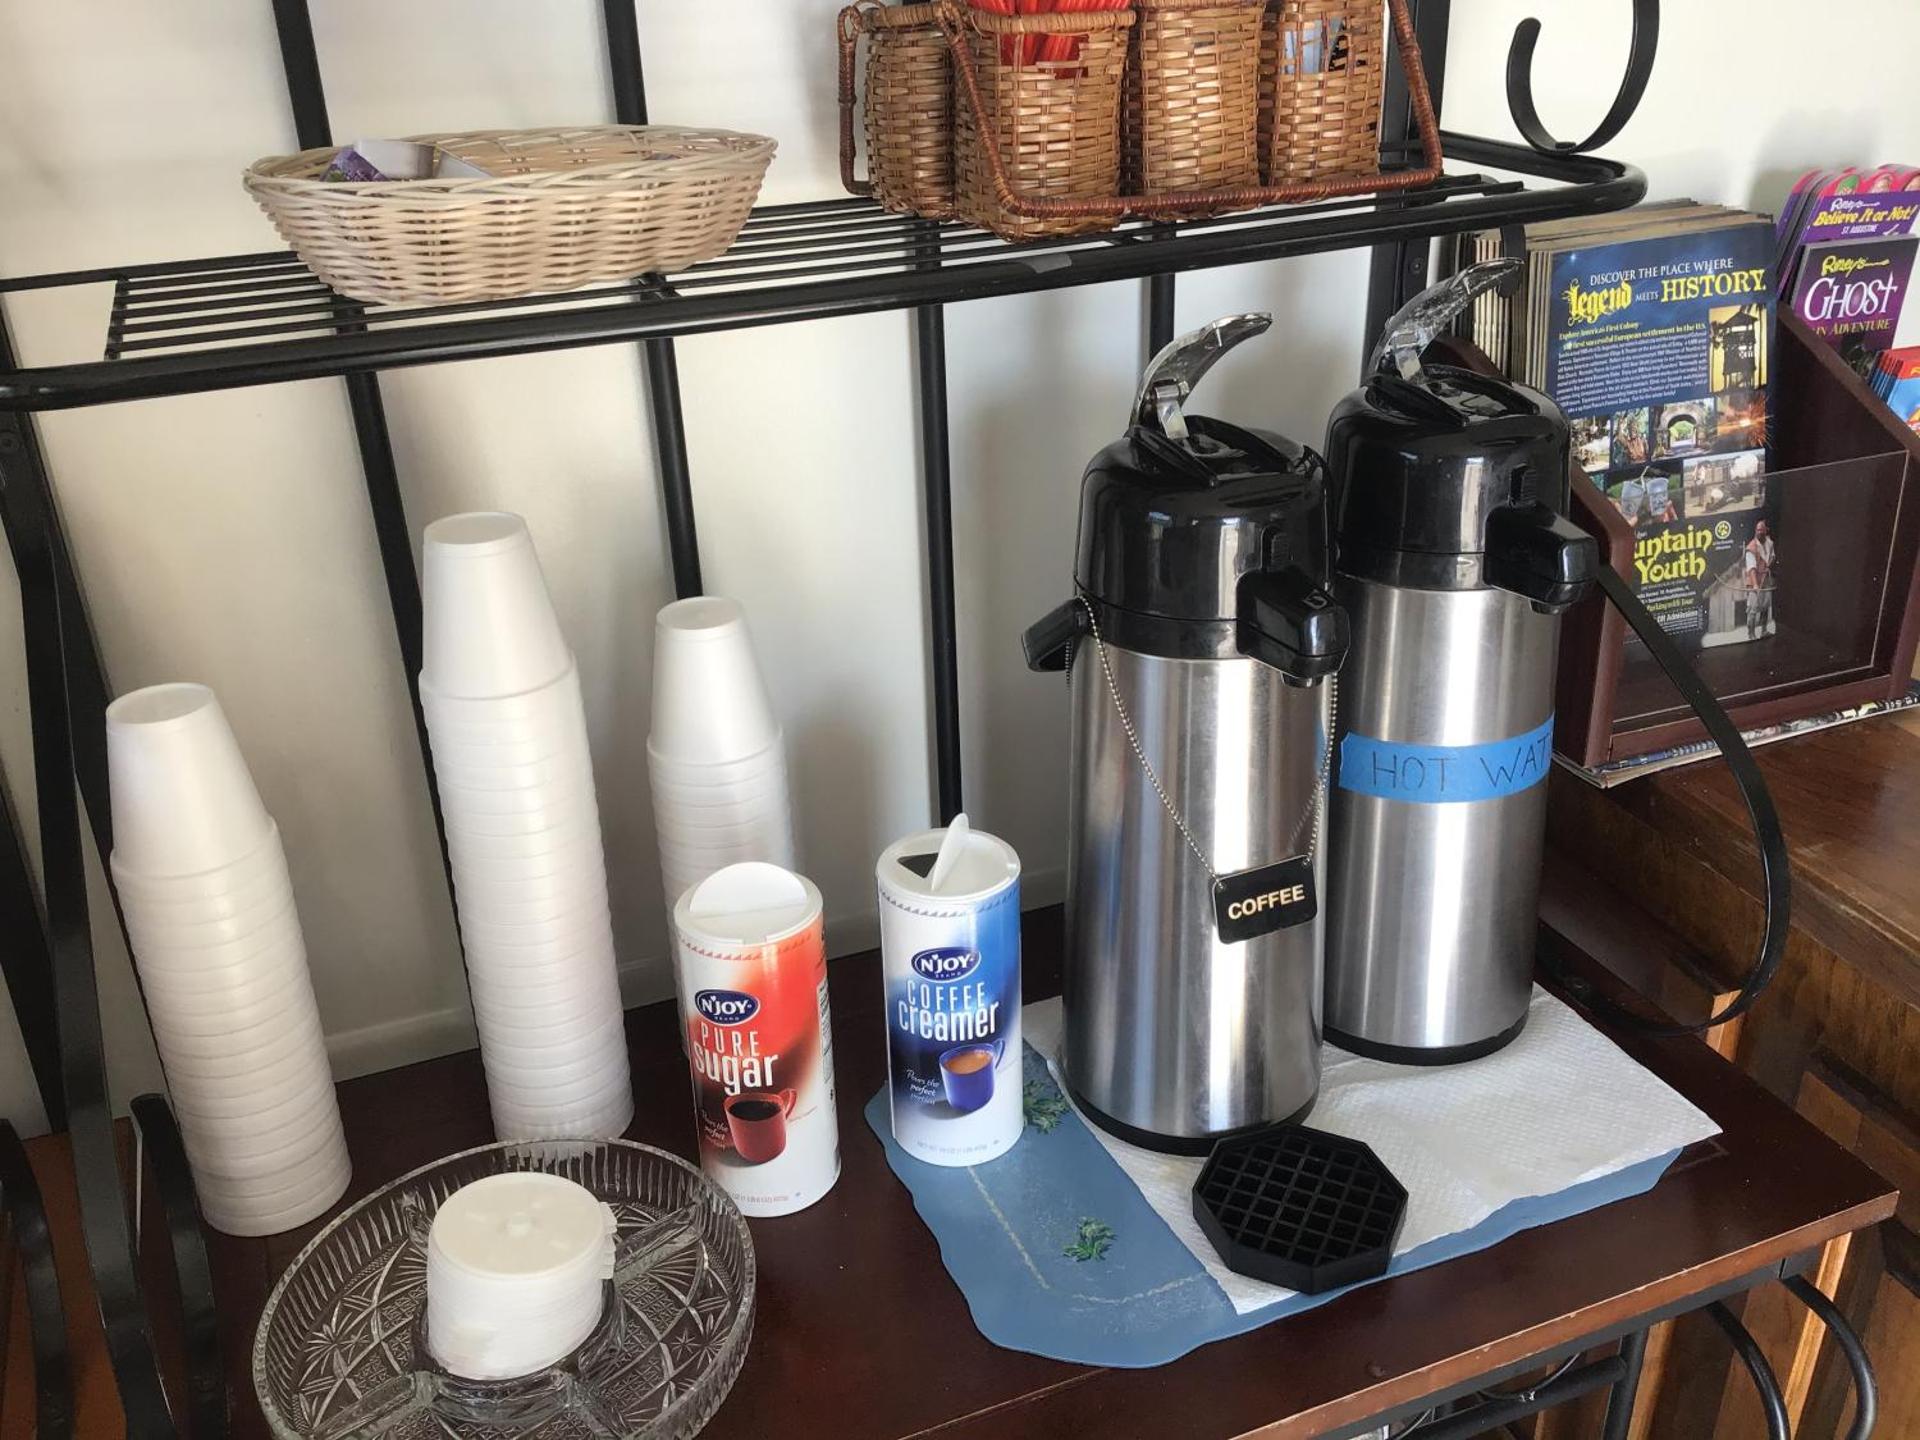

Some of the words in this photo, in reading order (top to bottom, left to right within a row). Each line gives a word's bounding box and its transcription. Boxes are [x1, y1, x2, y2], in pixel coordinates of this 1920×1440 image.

[1812, 211, 1859, 226] Believe
[1872, 211, 1888, 222] or
[1887, 204, 1919, 221] Not!
[1590, 269, 1637, 286] DISCOVER
[1638, 267, 1658, 280] THE
[1660, 264, 1690, 276] PLACE
[1693, 258, 1734, 273] WHERE
[1804, 271, 1898, 321] GHOST
[1832, 319, 1890, 335] ADVENTURE
[1634, 551, 1706, 585] Youth
[1372, 751, 1455, 793] HOT
[1227, 883, 1306, 920] COFFEE
[907, 979, 985, 1012] COFFEE
[701, 1021, 761, 1058] PURE
[898, 1000, 999, 1042] creamer
[694, 1041, 779, 1097] sugar
